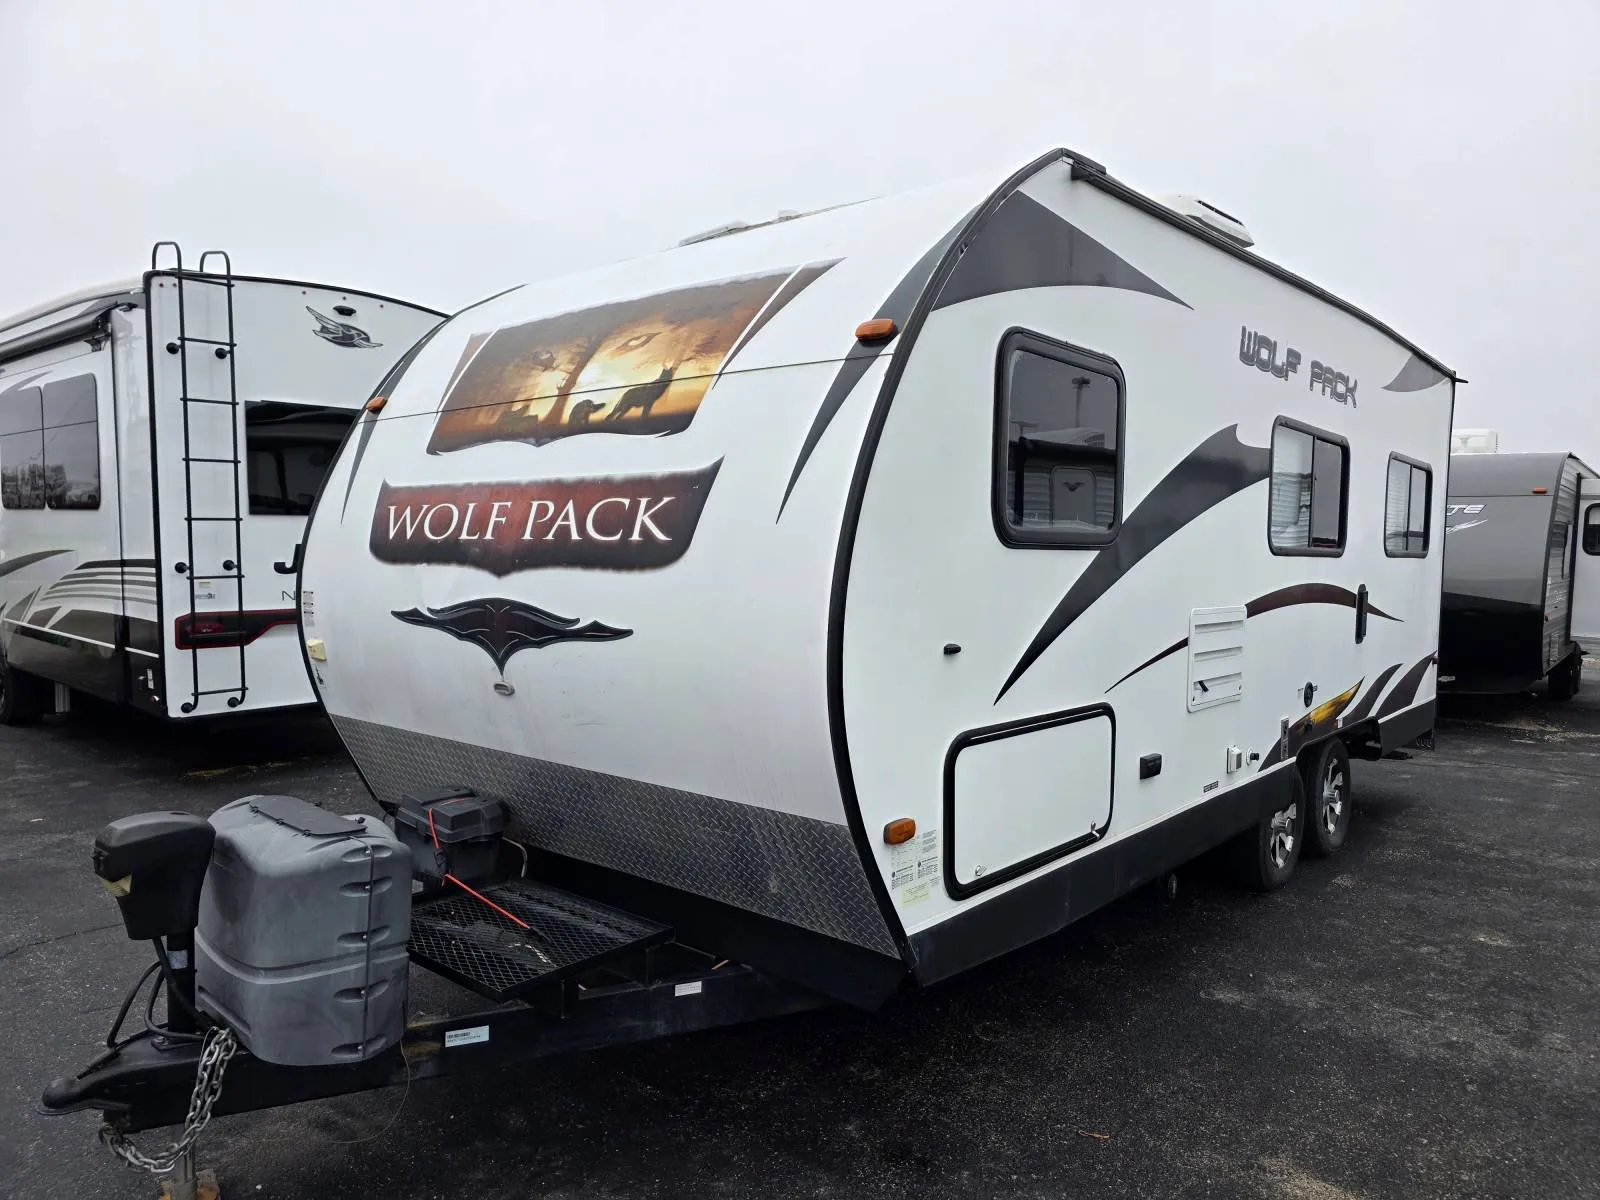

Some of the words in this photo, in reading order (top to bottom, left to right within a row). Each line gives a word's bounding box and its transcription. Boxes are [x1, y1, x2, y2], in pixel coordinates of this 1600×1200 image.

[1239, 325, 1302, 381] WOLF
[1309, 359, 1358, 408] PACK
[387, 500, 513, 541] WOLF
[520, 496, 676, 542] PACK
[1447, 504, 1487, 516] TE
